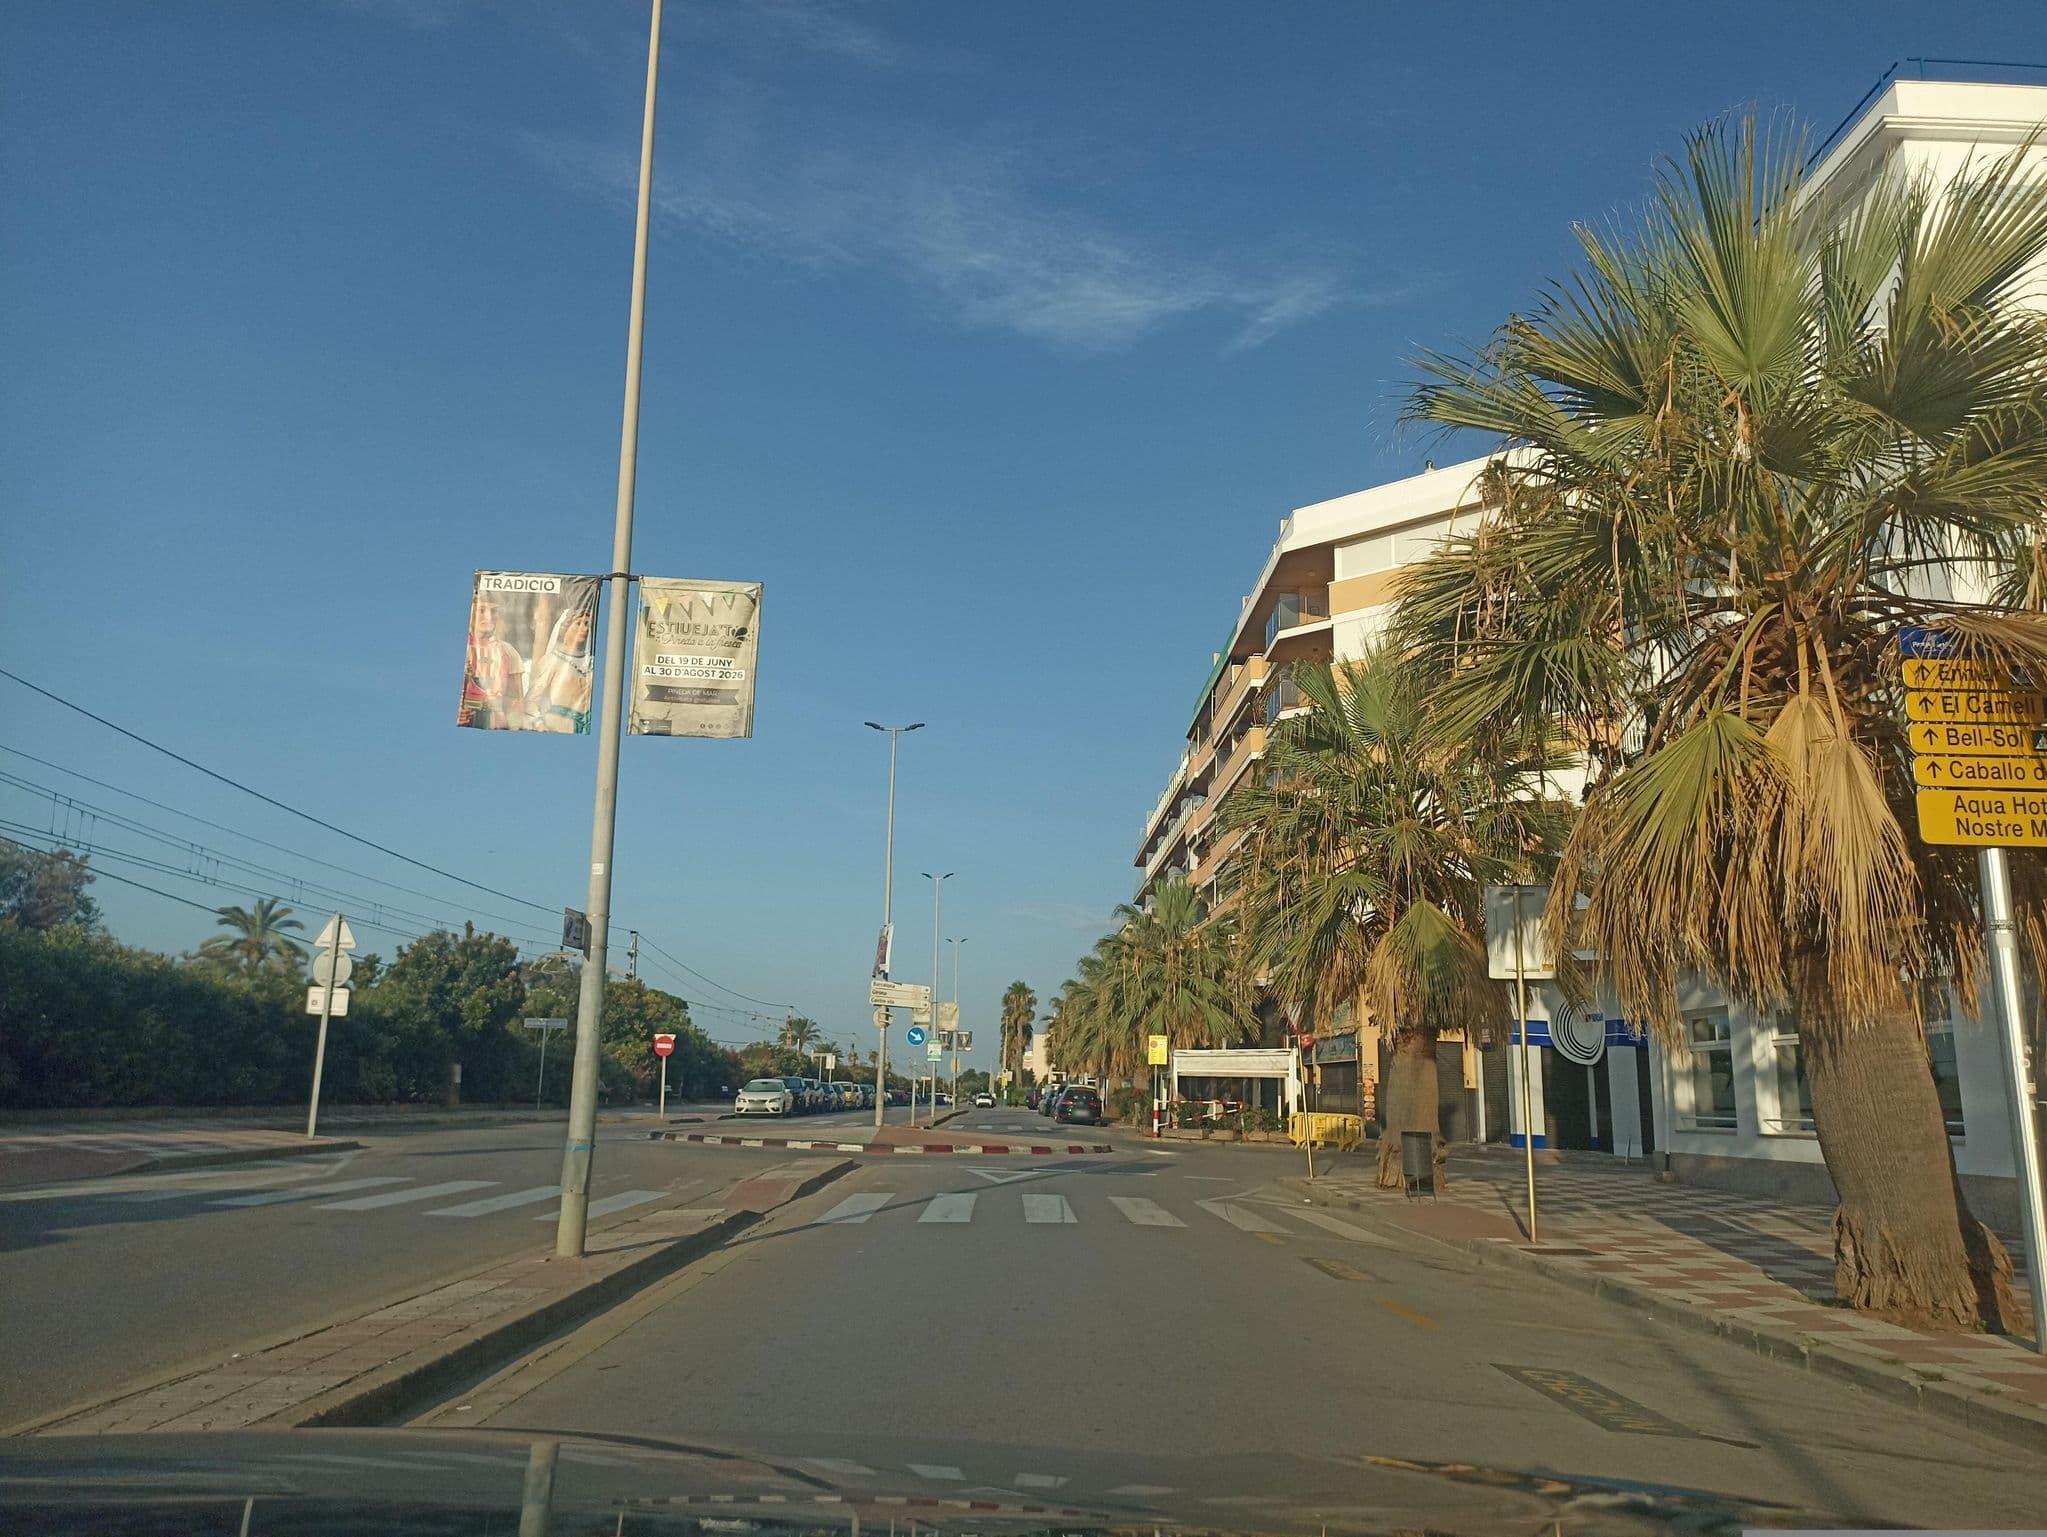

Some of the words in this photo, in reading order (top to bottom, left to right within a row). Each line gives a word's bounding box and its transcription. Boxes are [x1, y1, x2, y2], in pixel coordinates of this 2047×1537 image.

[484, 578, 555, 591] TRADICIÓ
[657, 656, 675, 665] DEL
[679, 657, 689, 665] 19
[691, 657, 704, 666] DE
[706, 658, 732, 667] JUNY
[644, 666, 656, 674] AL
[659, 667, 672, 675] 30
[674, 668, 716, 677] D'AGOST
[718, 670, 743, 679] 2026
[1941, 695, 1960, 714] El
[1966, 695, 2036, 715] Camell
[1946, 728, 2024, 747] Bell-Sol
[1949, 760, 2026, 780] Caballo
[1953, 795, 2006, 818] Aqua
[1956, 817, 2024, 837] Nostre
